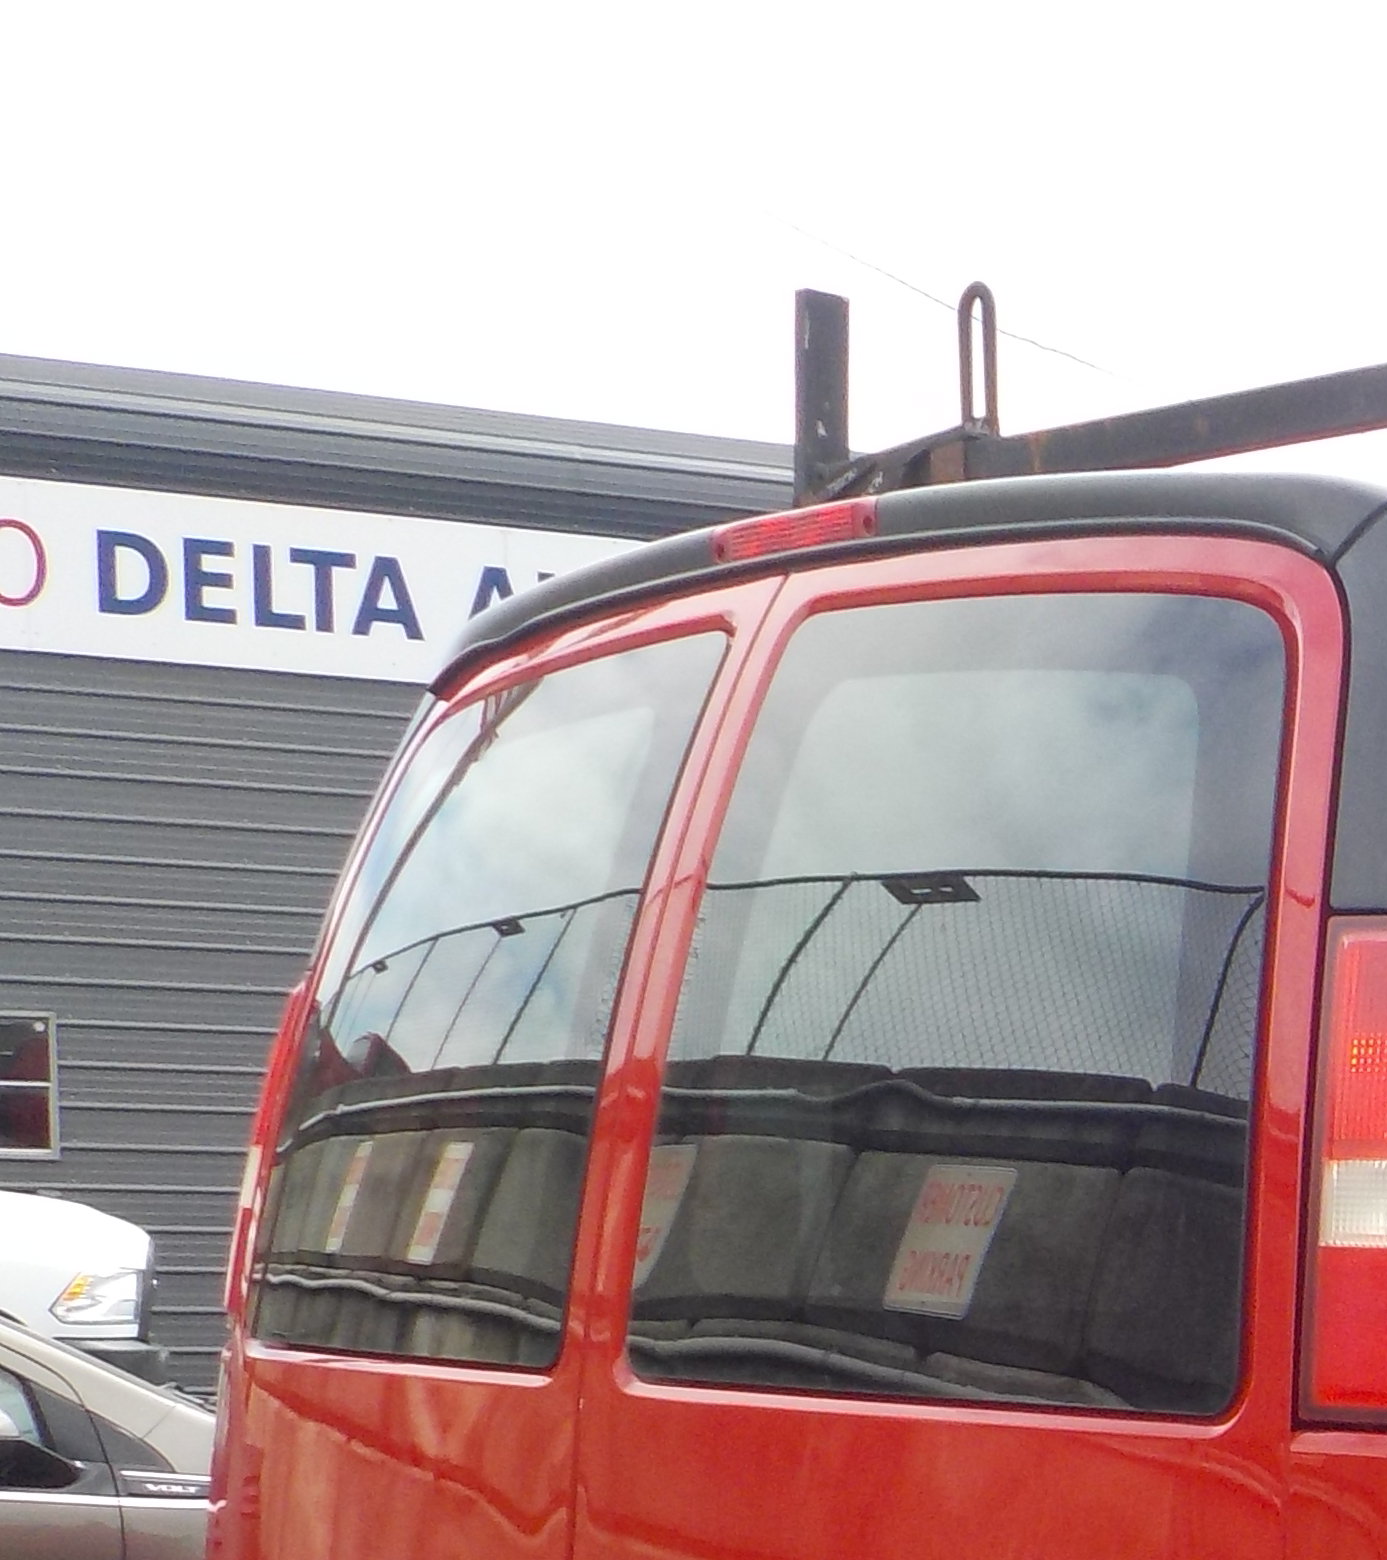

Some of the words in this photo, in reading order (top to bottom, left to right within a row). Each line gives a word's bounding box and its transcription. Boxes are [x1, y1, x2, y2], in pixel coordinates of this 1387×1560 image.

[95, 529, 425, 642] DELTA
[468, 565, 556, 621] A
[144, 1483, 199, 1494] VOLT
